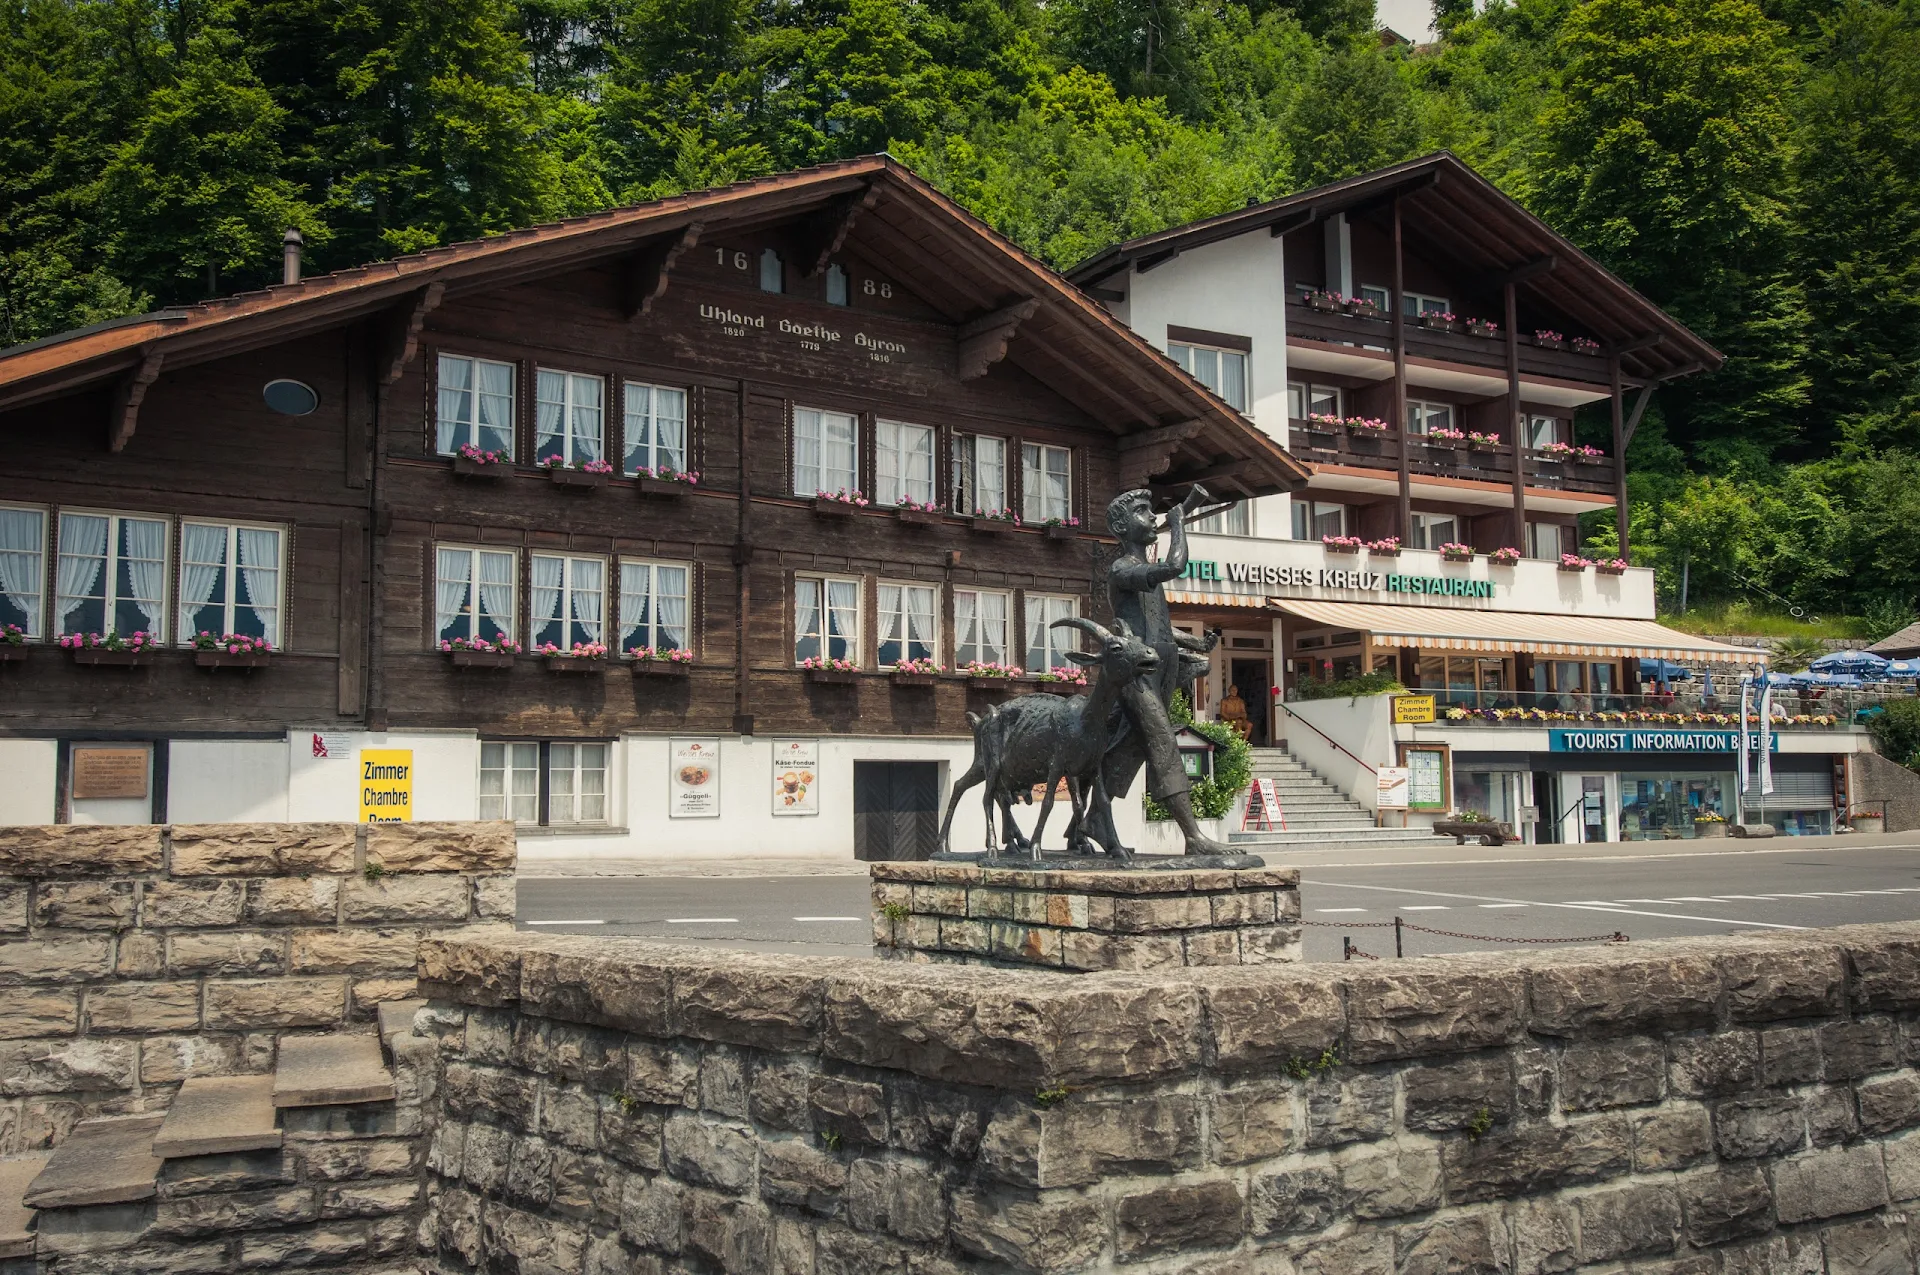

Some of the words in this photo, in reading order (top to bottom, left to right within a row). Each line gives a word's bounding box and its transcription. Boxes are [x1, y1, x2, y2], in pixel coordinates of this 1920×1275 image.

[715, 248, 748, 270] 16
[863, 279, 893, 299] 88
[723, 326, 745, 338] 1820
[779, 318, 841, 343] Goethe
[854, 331, 906, 354] Byron
[1229, 563, 1314, 587] WEISSES
[1320, 568, 1382, 592] KREUZ
[1387, 574, 1496, 598] RESTAURANT
[1397, 706, 1431, 714] Chambre
[1399, 698, 1428, 706] Zimmer
[1564, 732, 1626, 750] TOURIST
[1633, 732, 1726, 750] INFORMATION
[1731, 734, 1774, 750] BIEZ
[364, 762, 409, 780] Zimmer
[364, 787, 408, 807] Chambre
